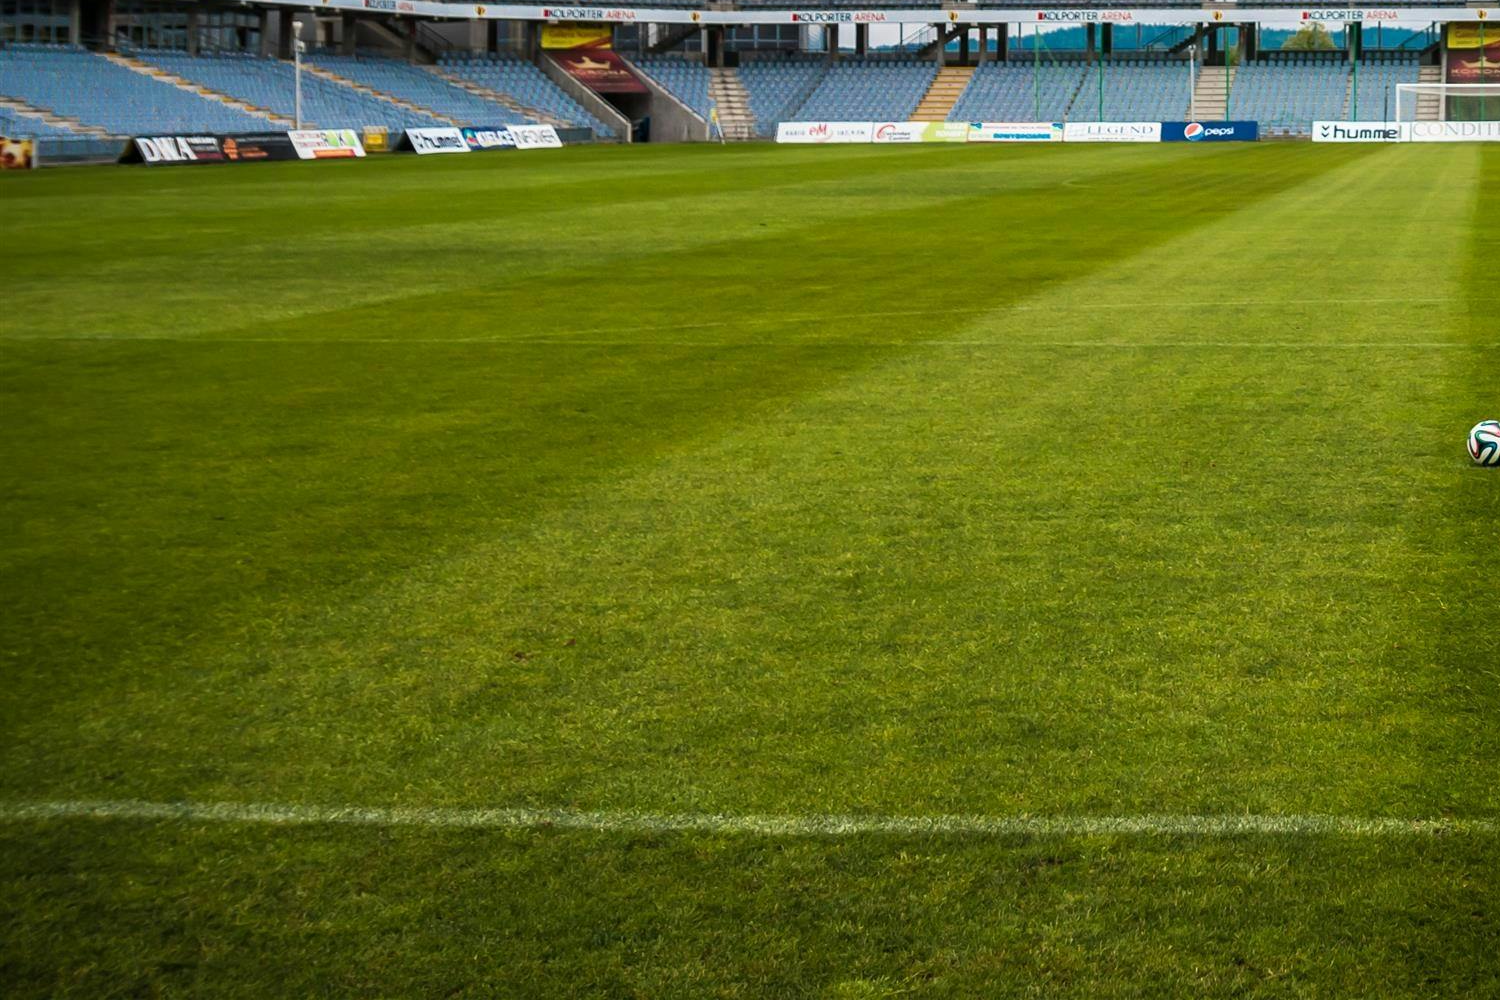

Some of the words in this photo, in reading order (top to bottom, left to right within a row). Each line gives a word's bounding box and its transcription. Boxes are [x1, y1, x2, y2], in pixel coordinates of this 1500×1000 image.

[549, 8, 602, 18] KOLPORTER
[606, 9, 636, 19] ARENA
[797, 12, 851, 21] KOLPORTER
[854, 12, 886, 20] ARENA
[1044, 11, 1098, 20] KOLPORTER
[1101, 11, 1132, 20] ARENA
[1309, 10, 1363, 19] KOLPORTER
[1366, 10, 1398, 19] ARENA
[1087, 125, 1153, 134] LEGEND
[1205, 126, 1234, 137] pepsi
